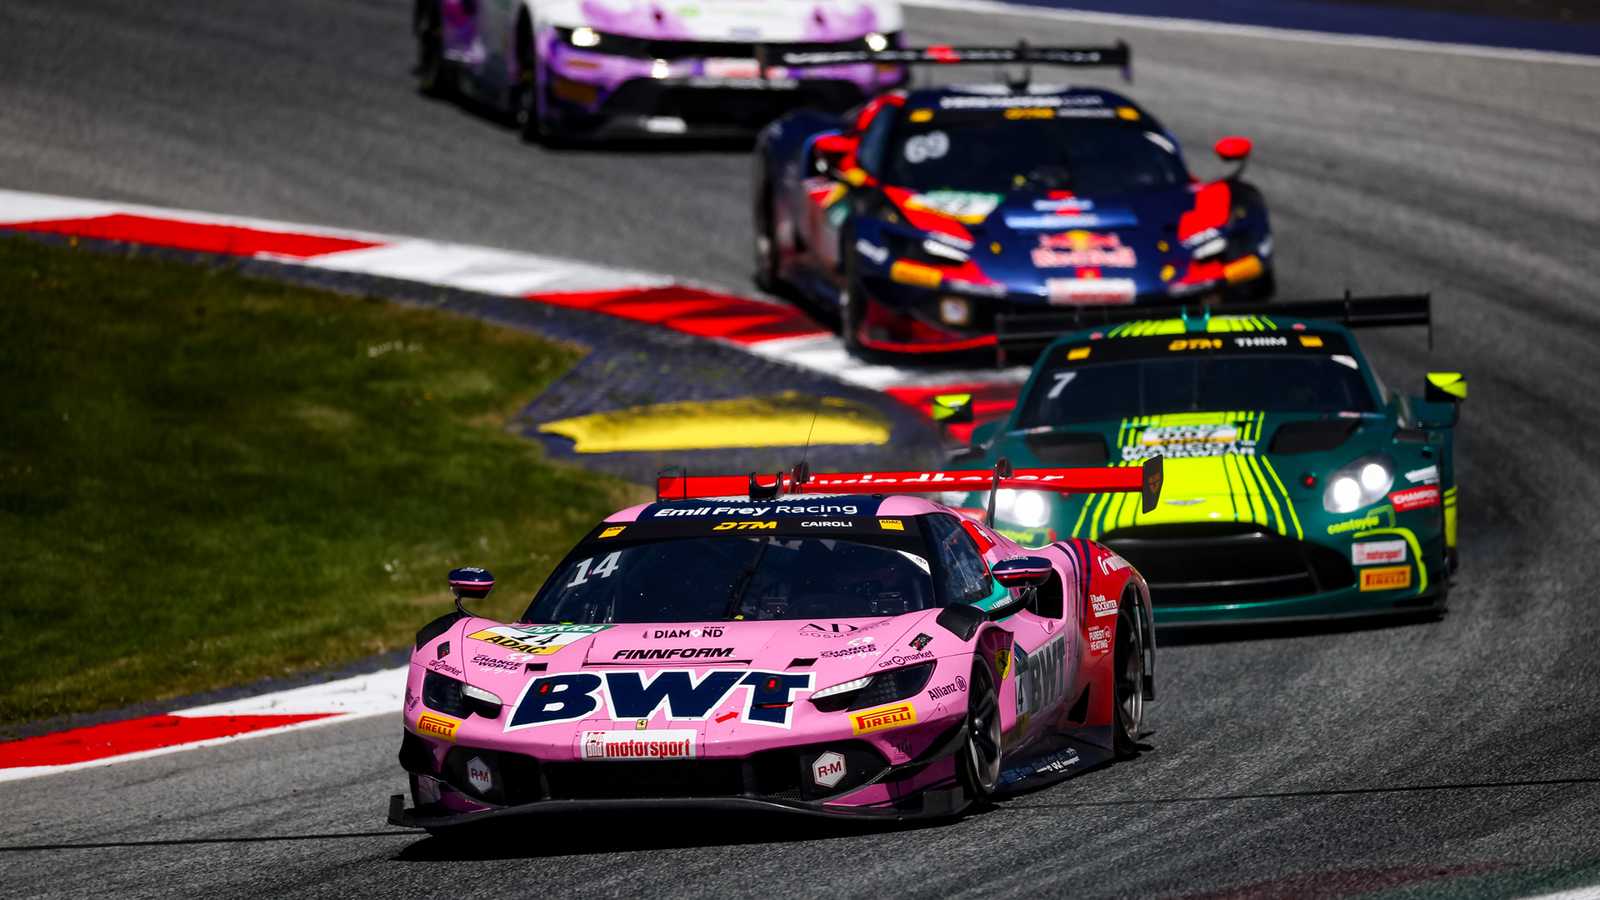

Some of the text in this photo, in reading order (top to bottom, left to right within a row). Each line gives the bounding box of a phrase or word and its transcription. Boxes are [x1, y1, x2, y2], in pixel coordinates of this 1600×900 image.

[904, 130, 949, 163] 69
[1047, 372, 1077, 399] 7
[654, 502, 858, 517] Emil Frey Racing
[712, 520, 853, 530] DTM CAIROLI
[566, 551, 623, 589] 14
[484, 634, 547, 654] ADAC
[505, 669, 815, 731] BWT
[927, 682, 958, 701] Allianz
[419, 715, 456, 737] PIRELLI
[856, 706, 912, 730] PIRELLI
[605, 738, 691, 759] motorsport
